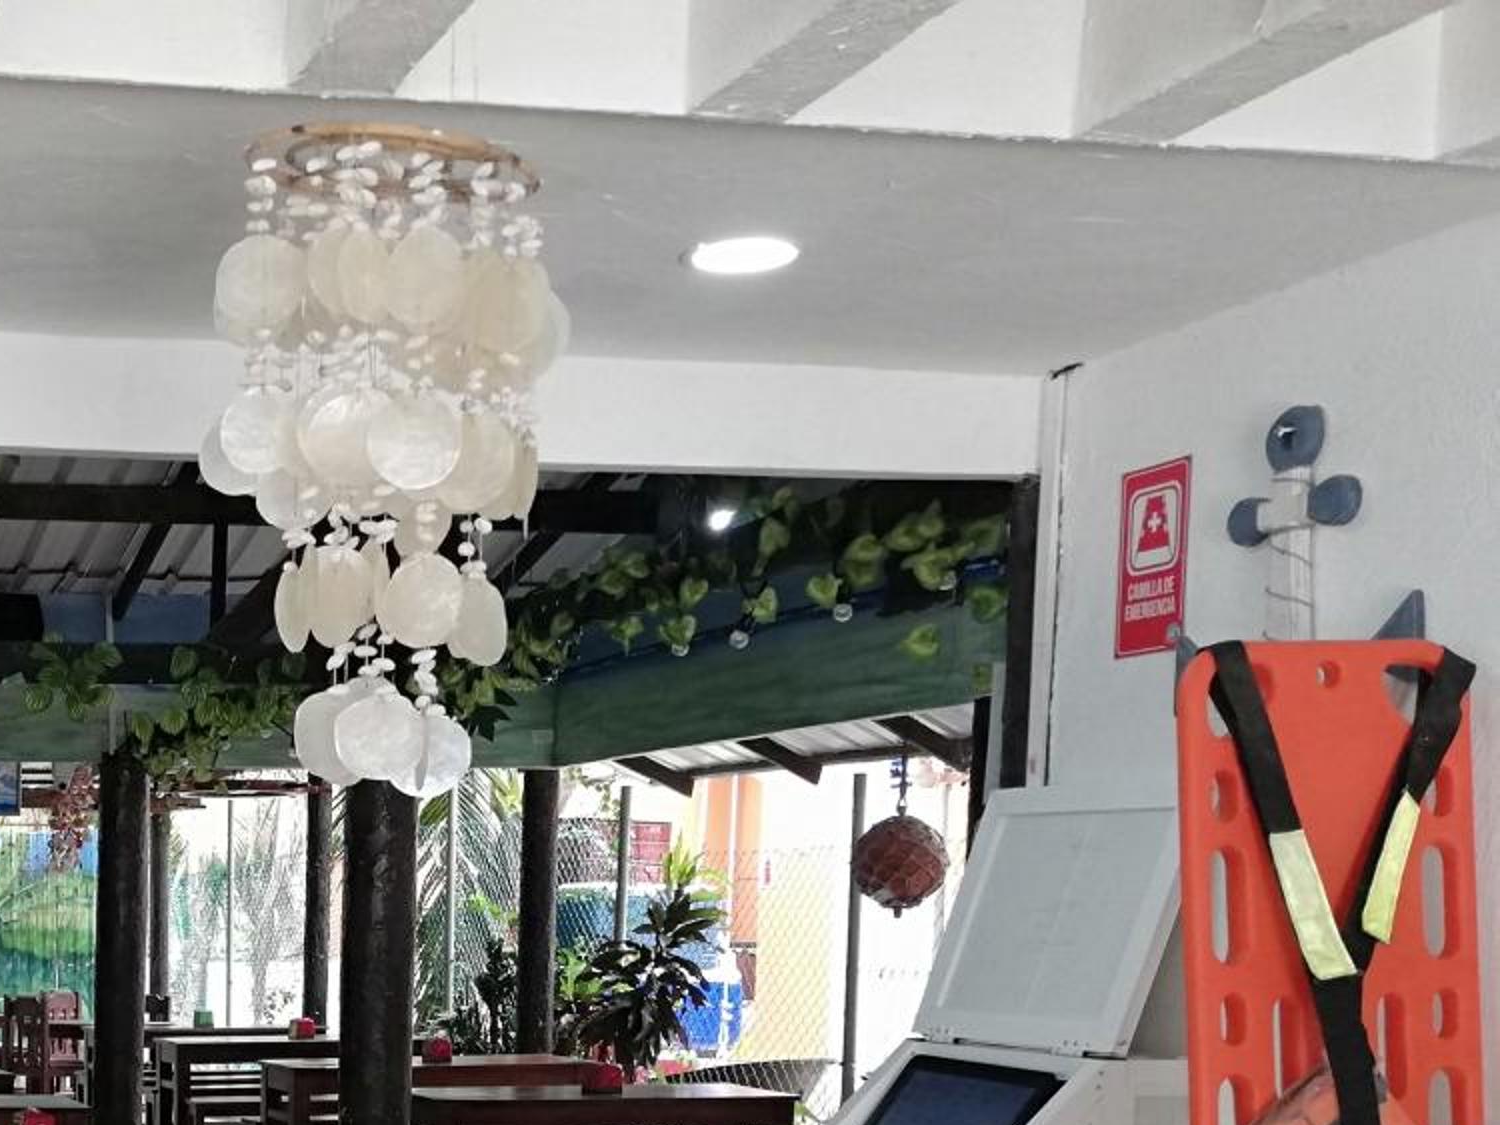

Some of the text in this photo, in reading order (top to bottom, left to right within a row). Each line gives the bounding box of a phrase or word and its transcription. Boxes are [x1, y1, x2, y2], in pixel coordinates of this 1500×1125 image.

[1128, 576, 1175, 602] CAMILLA DE
[1125, 595, 1176, 621] EMERGENCIA
